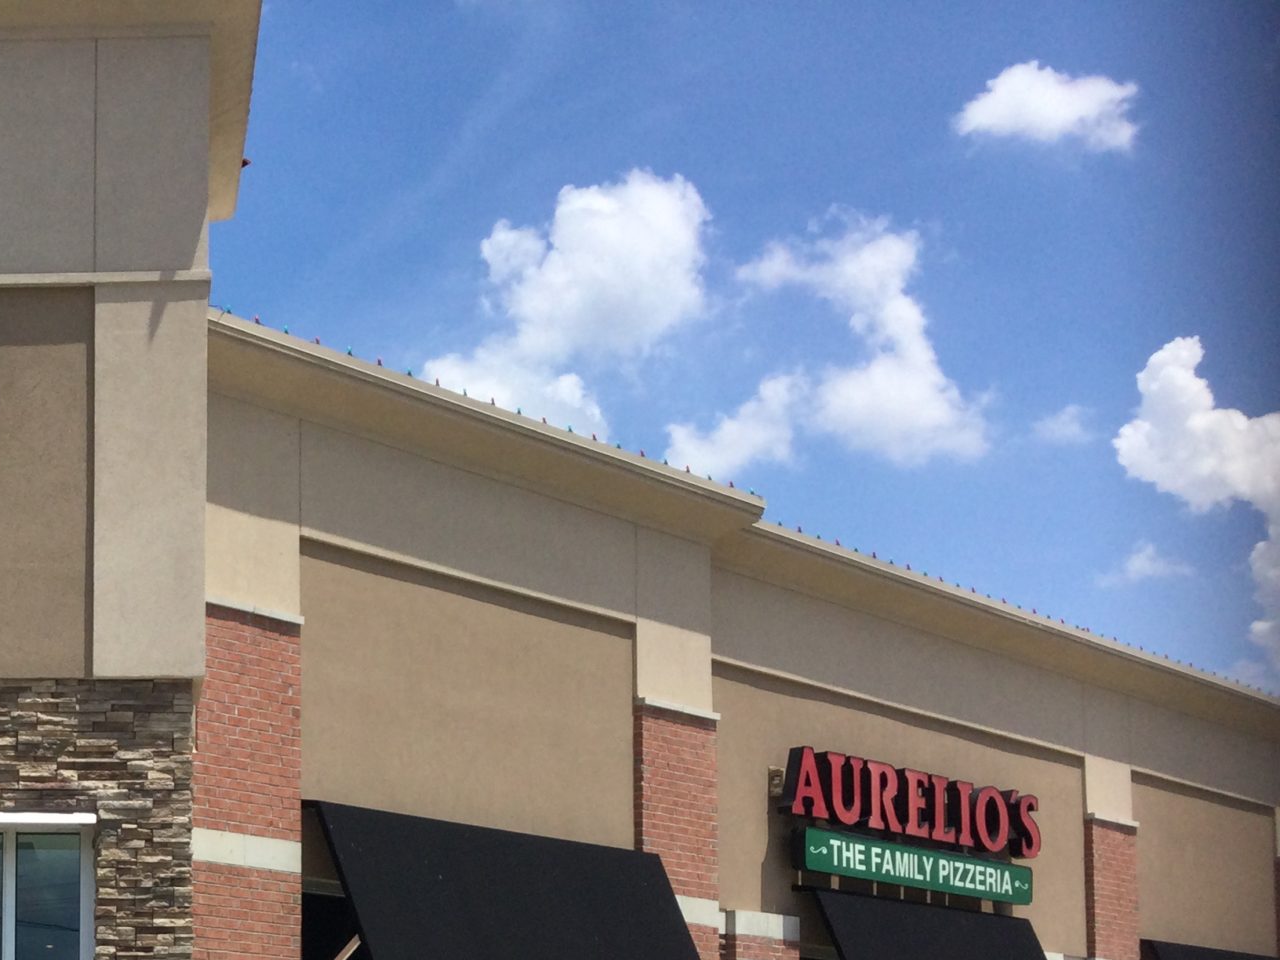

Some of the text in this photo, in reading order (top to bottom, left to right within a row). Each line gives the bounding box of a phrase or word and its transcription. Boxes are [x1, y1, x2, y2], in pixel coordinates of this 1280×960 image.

[789, 745, 1042, 859] AURELIO'S
[829, 838, 1013, 896] THE FAMILY PIZZERIA
